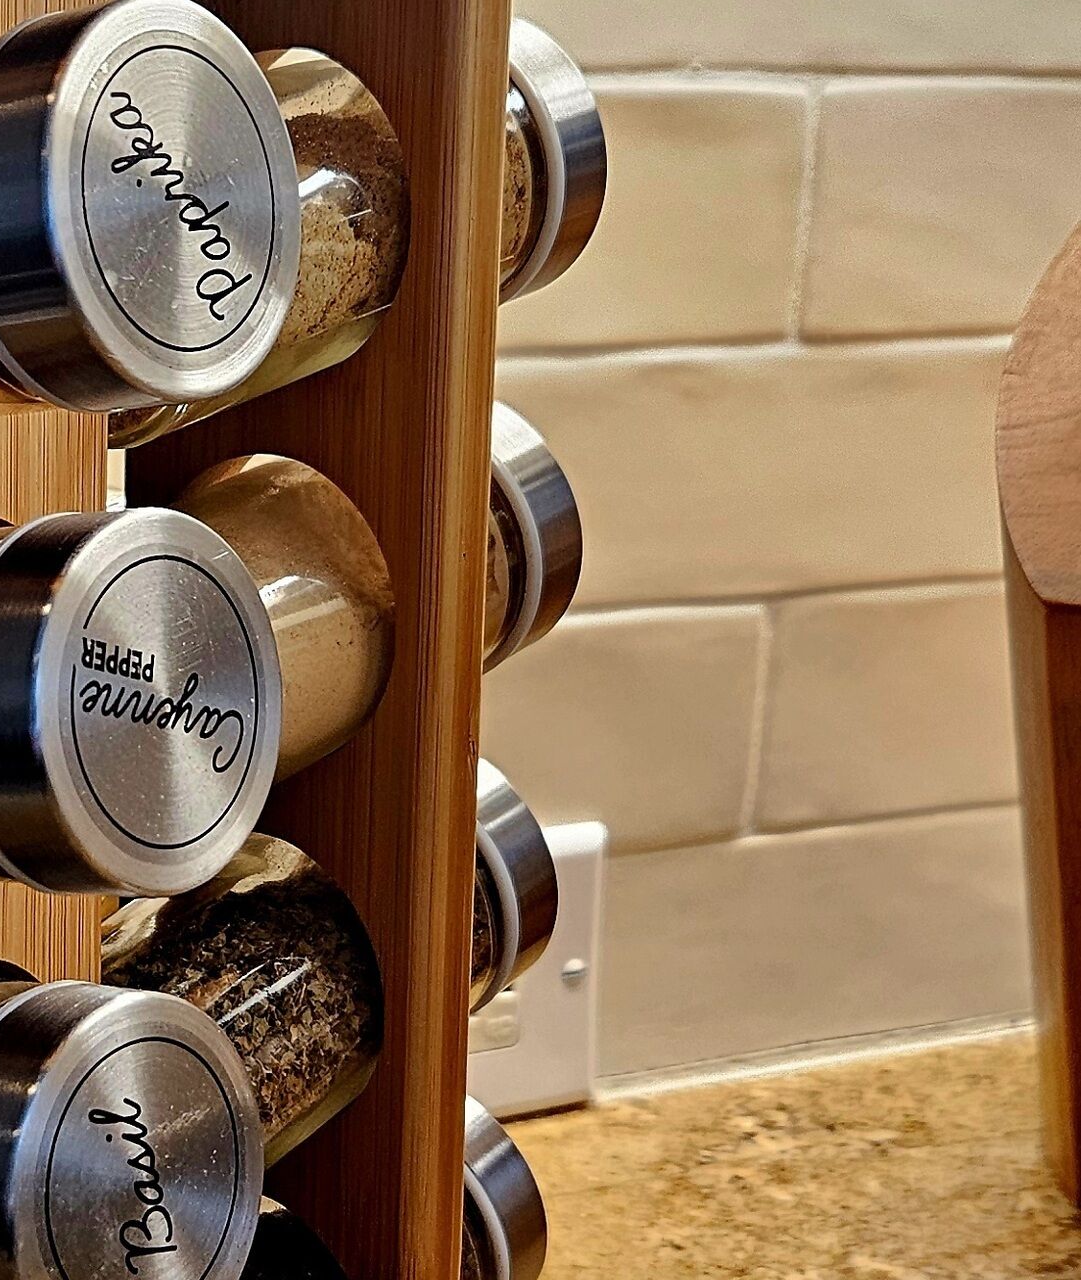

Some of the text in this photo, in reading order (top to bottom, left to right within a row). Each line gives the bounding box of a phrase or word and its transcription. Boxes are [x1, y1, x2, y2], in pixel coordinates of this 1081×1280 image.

[110, 91, 252, 321] Paprika
[80, 672, 244, 773] Cayenne
[81, 636, 155, 683] PEPPER
[88, 1097, 177, 1275] Basil
